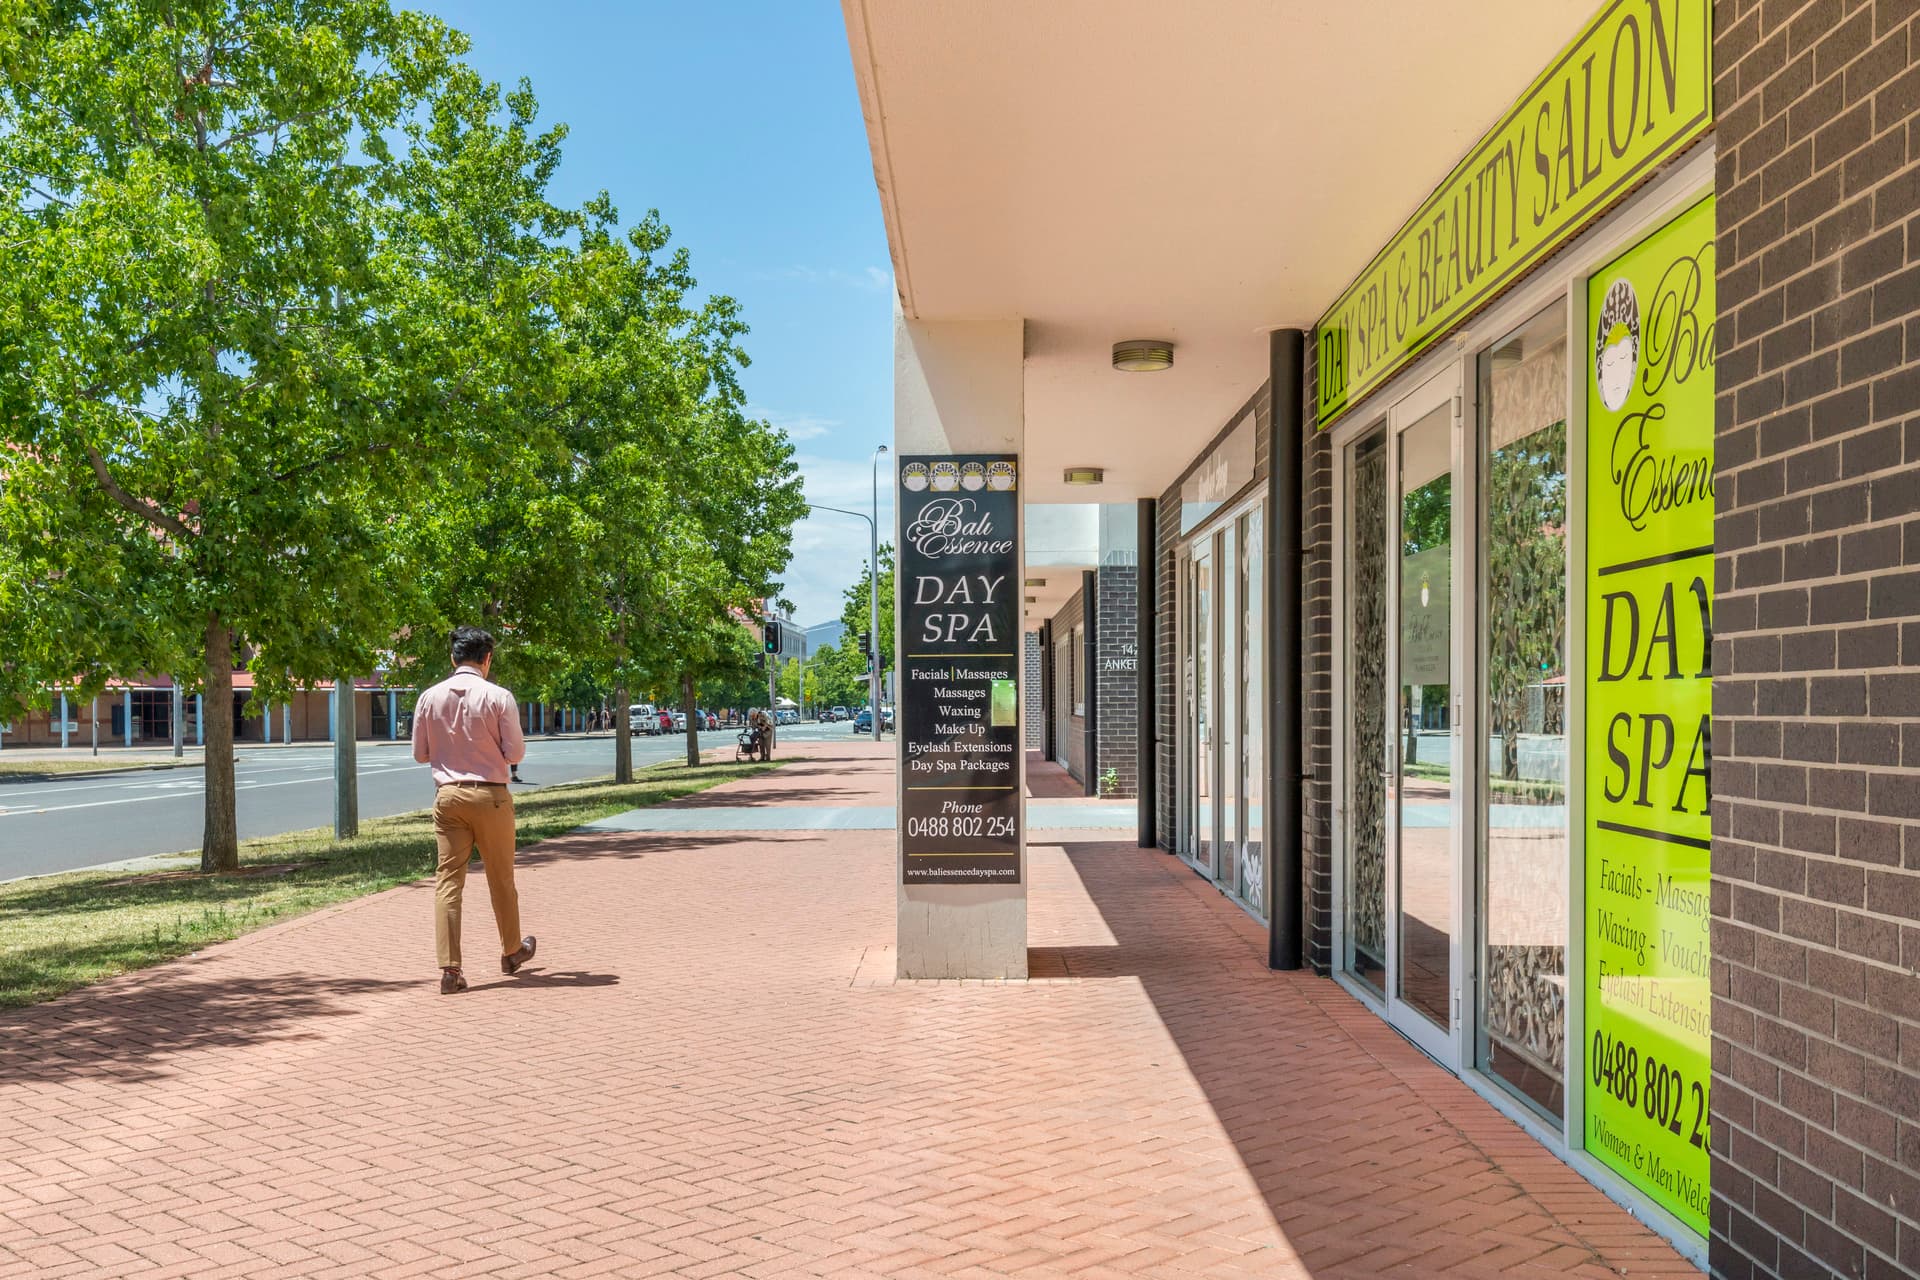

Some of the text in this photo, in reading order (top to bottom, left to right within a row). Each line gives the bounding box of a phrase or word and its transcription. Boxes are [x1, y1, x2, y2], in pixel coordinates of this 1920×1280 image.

[1323, 0, 1680, 406] DAY SPA & BEAUTY SALON
[915, 498, 993, 537] Bali
[906, 520, 1013, 559] Essence
[914, 575, 1005, 605] DAY
[922, 613, 998, 643] SPA
[911, 668, 1009, 681] Facials Massages
[933, 687, 986, 700] Massages
[938, 705, 982, 719] Waxing
[934, 723, 986, 737] Make Up
[907, 741, 1013, 755] Eyelash Extensions
[911, 760, 1010, 773] Day Spa Packages
[1604, 712, 1711, 817] SPA
[940, 800, 983, 814] Phone
[907, 816, 1016, 837] 0488 802 254
[906, 867, 1016, 878] www.baliessencedayspa.com
[1600, 858, 1643, 900] Facials
[1598, 908, 1647, 966] Waxing
[1661, 929, 1711, 978] Vouch
[1598, 959, 1645, 1008] Eyelash
[1593, 1029, 1639, 1109] 0488
[1644, 1056, 1683, 1136] 802
[1593, 1115, 1631, 1162] Women
[1634, 1143, 1644, 1170] &
[1646, 1151, 1673, 1192] Men
